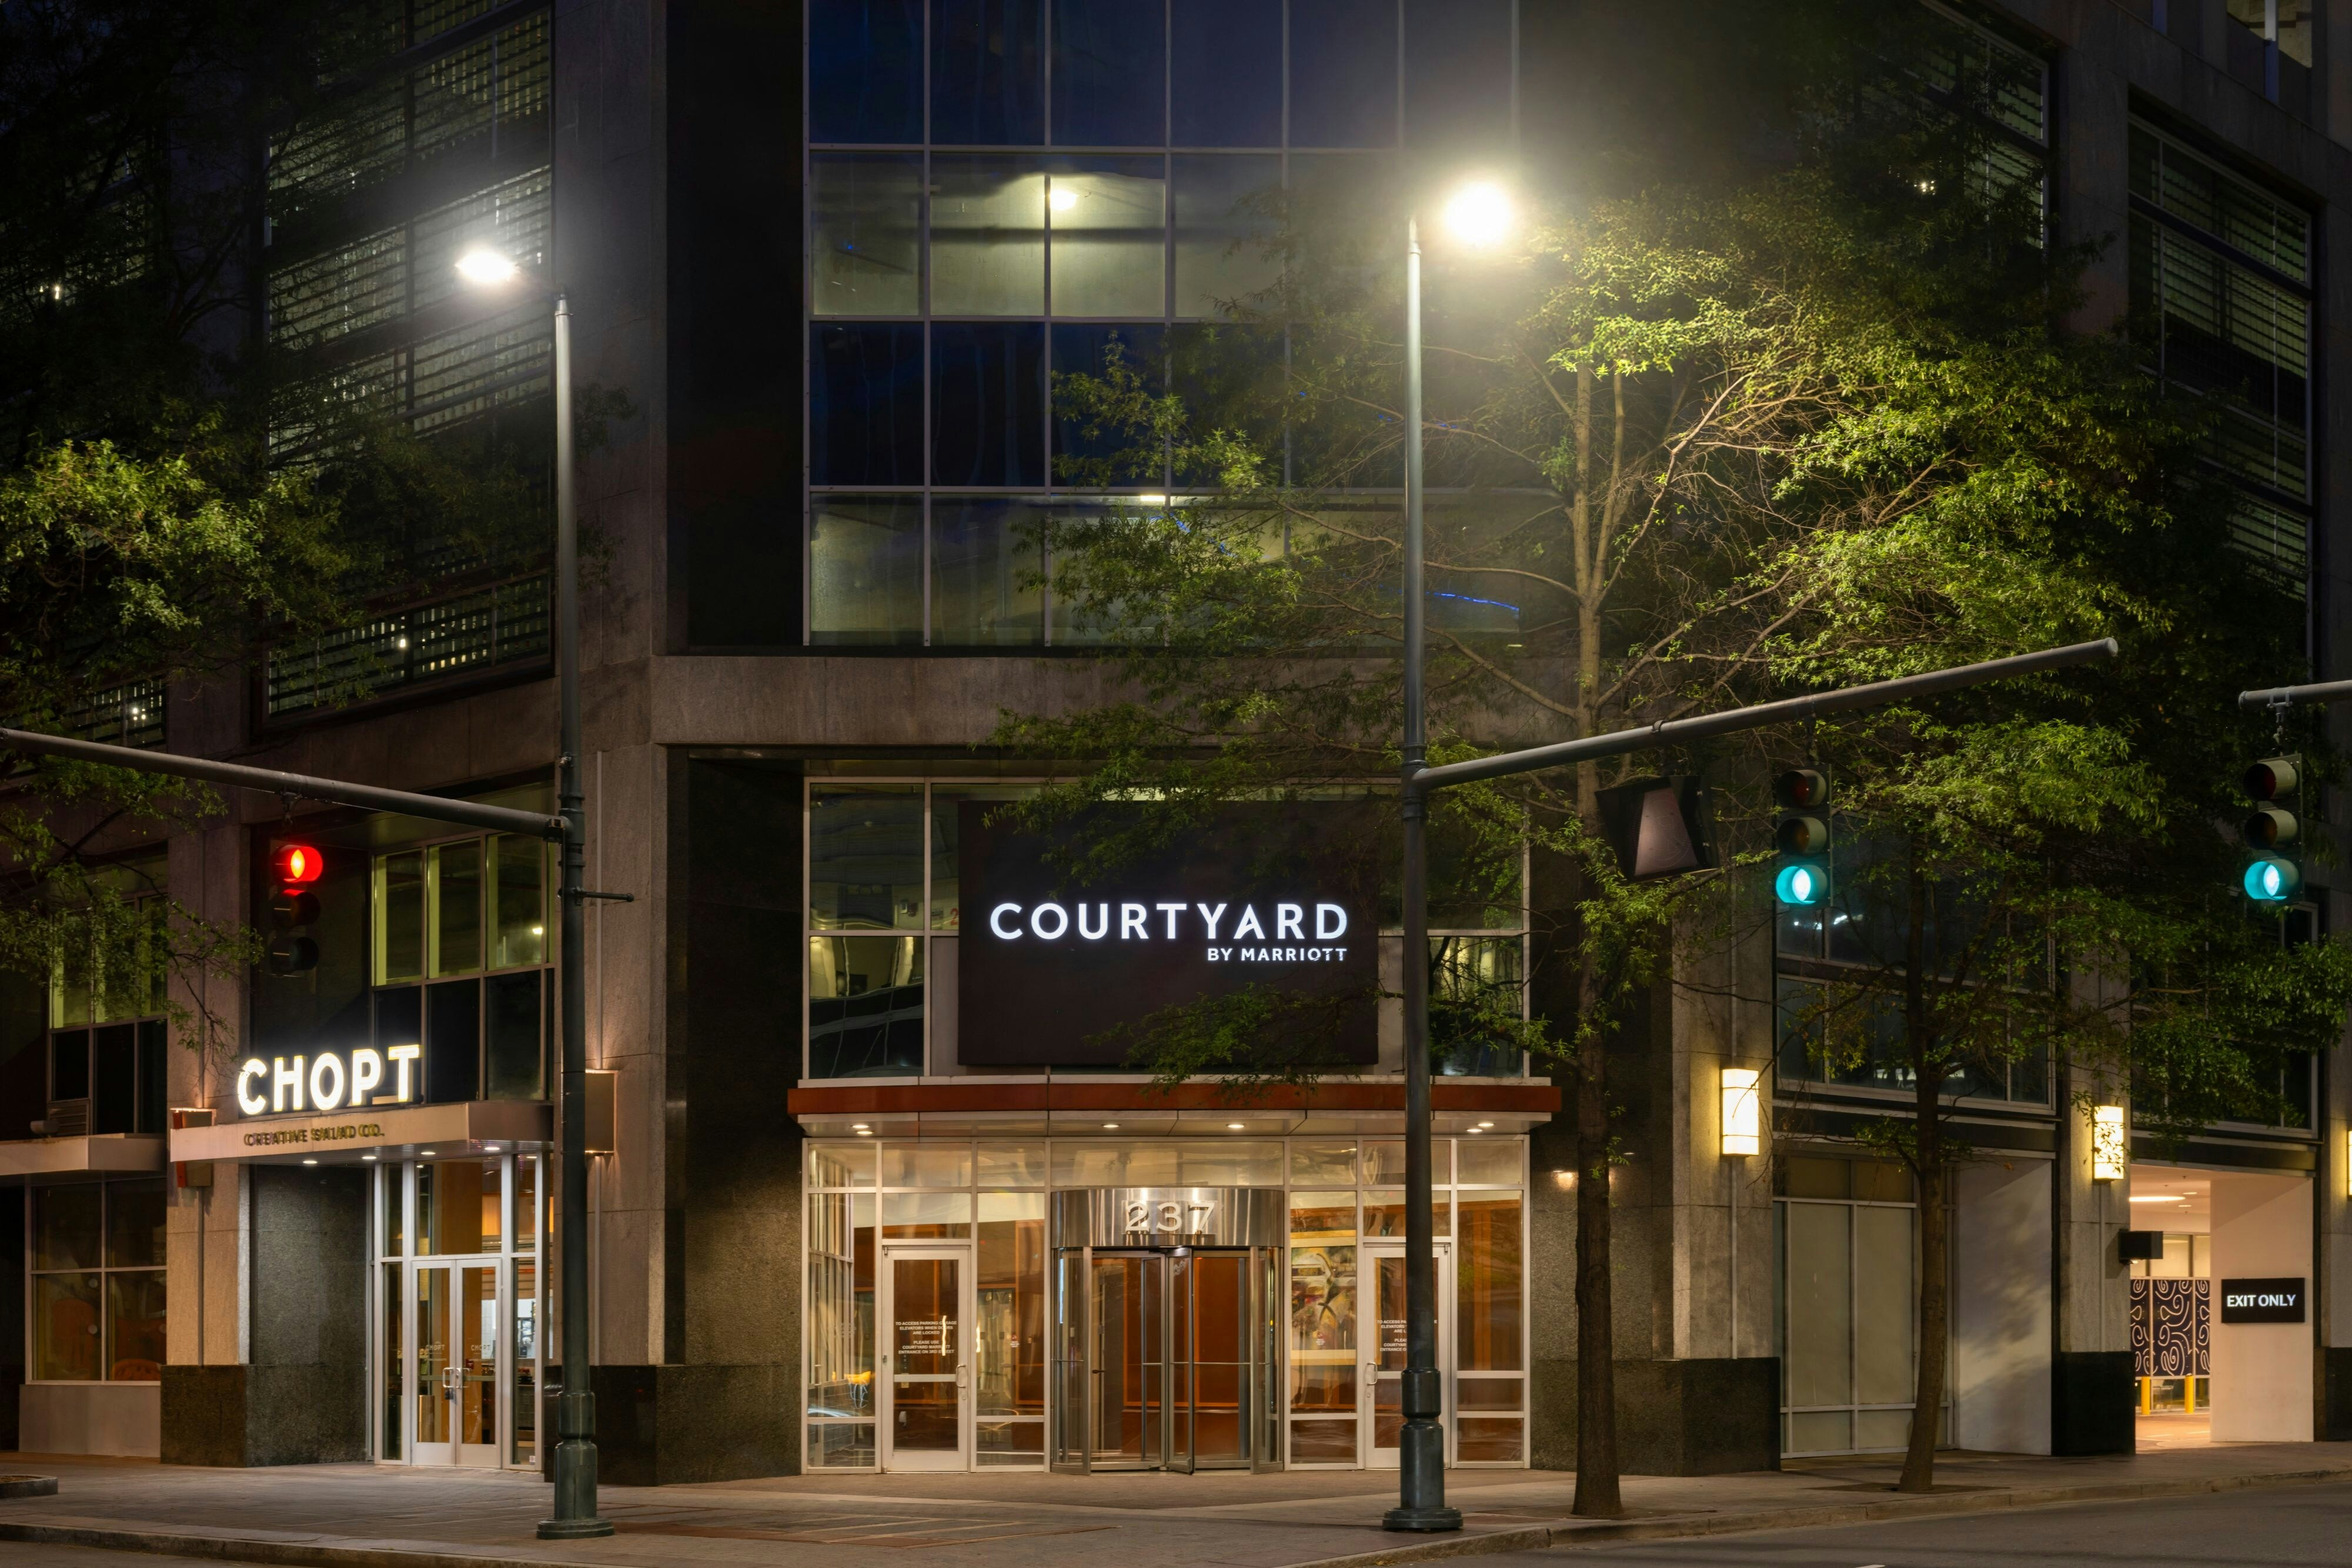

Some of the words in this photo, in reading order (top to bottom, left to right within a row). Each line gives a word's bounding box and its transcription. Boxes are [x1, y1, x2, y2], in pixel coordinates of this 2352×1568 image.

[990, 903, 1347, 940] COURTYARD
[1207, 948, 1233, 961] BY
[1241, 948, 1348, 961] MARRIOTT
[237, 1044, 421, 1115] CHOPT
[243, 1129, 308, 1146] CREATIVE
[310, 1125, 356, 1141] SALAD
[358, 1124, 385, 1137] CO.
[1125, 1201, 1216, 1232] 237
[2227, 1295, 2257, 1307] EXIT
[2258, 1294, 2296, 1306] ONLY
